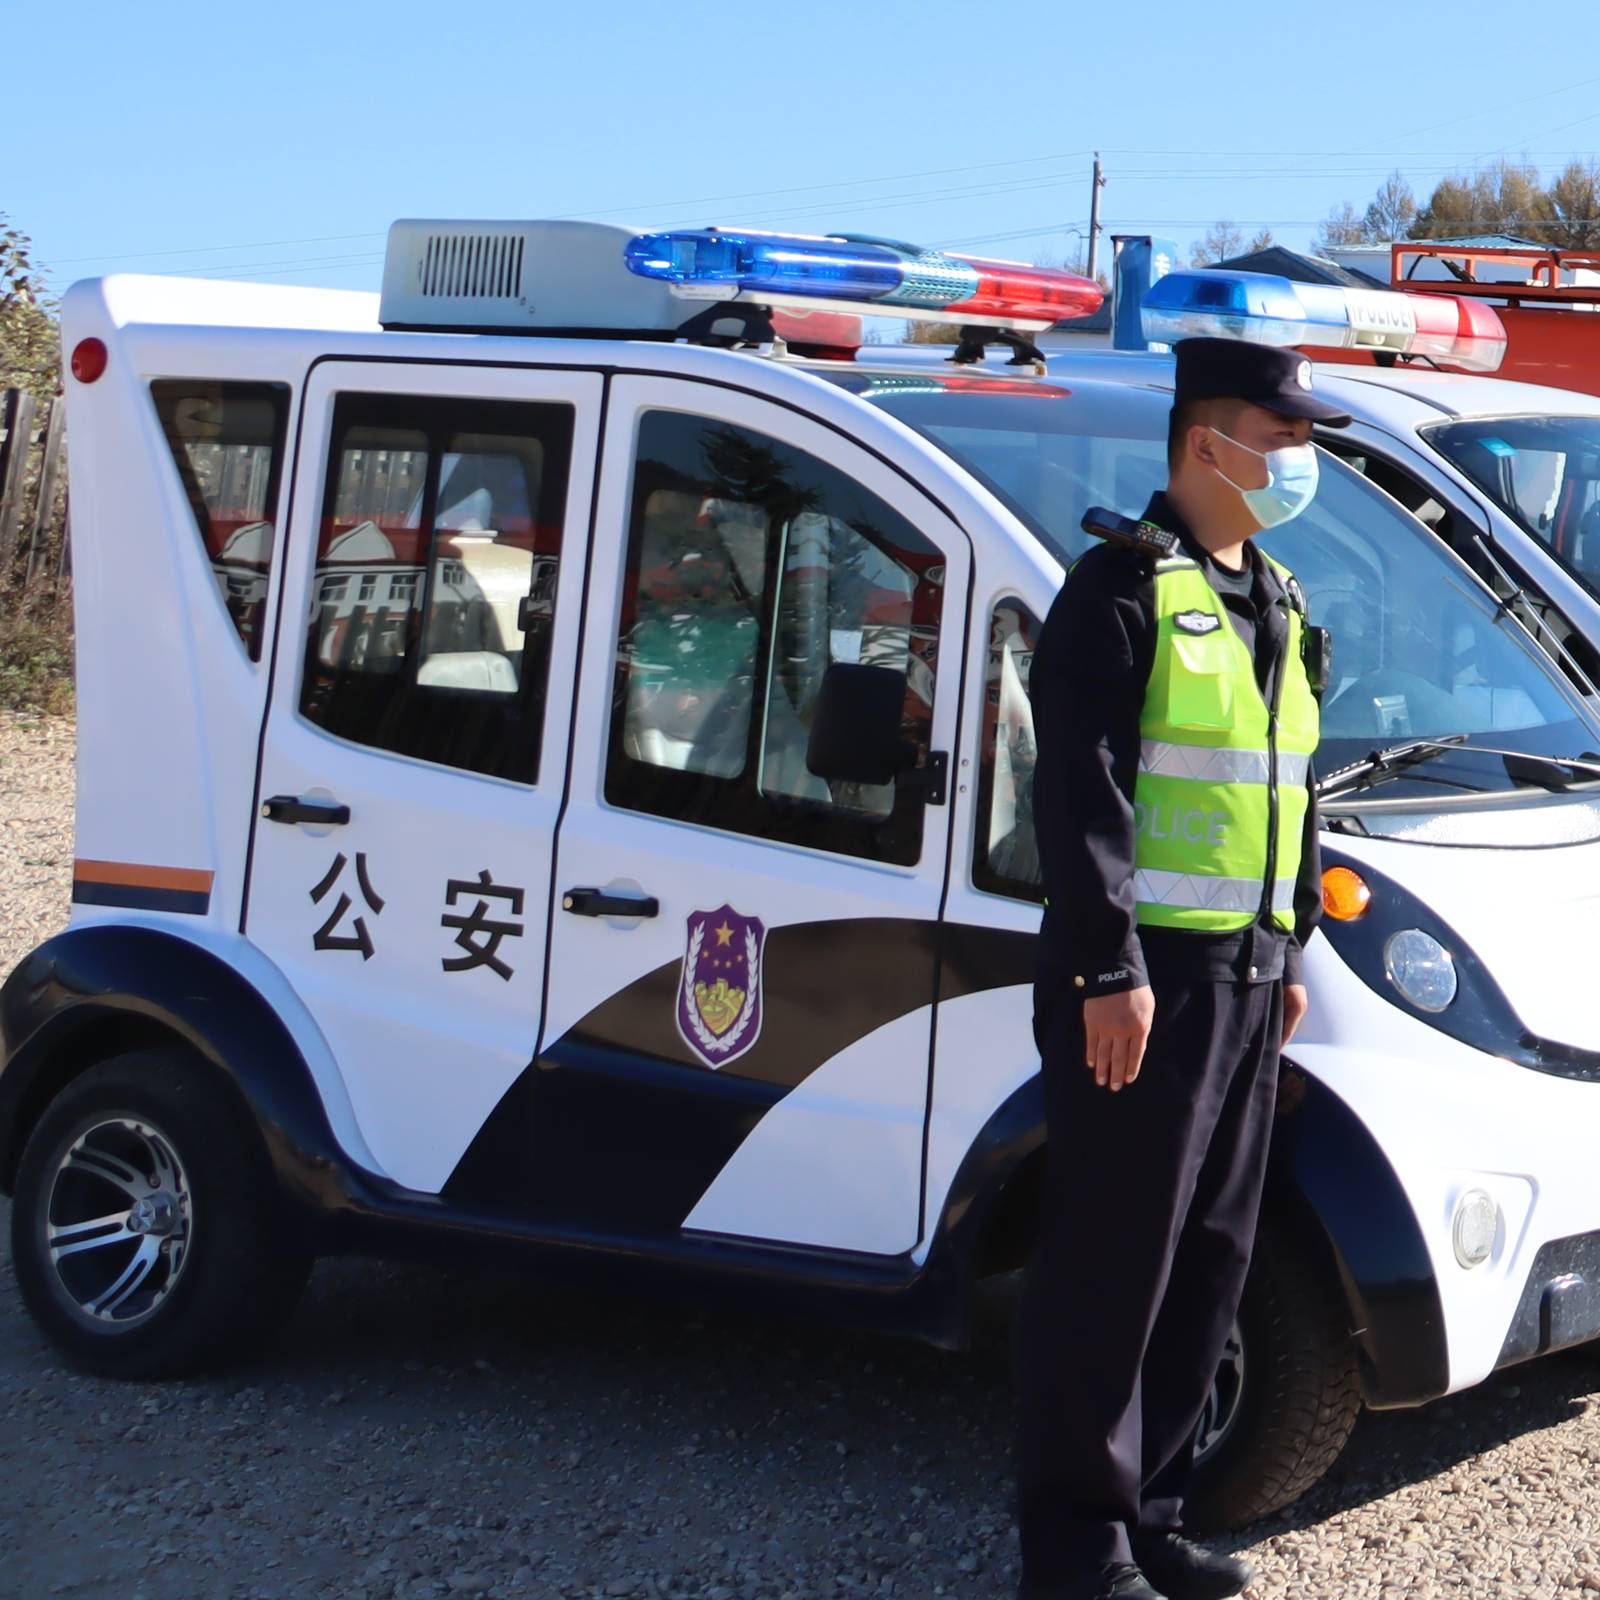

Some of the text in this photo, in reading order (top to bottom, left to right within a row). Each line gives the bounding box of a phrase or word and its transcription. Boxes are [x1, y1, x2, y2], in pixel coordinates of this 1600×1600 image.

[1356, 304, 1409, 328] POLICE
[1134, 802, 1230, 847] OLICE
[309, 851, 525, 982] 公安
[1098, 968, 1129, 984] POLICE
